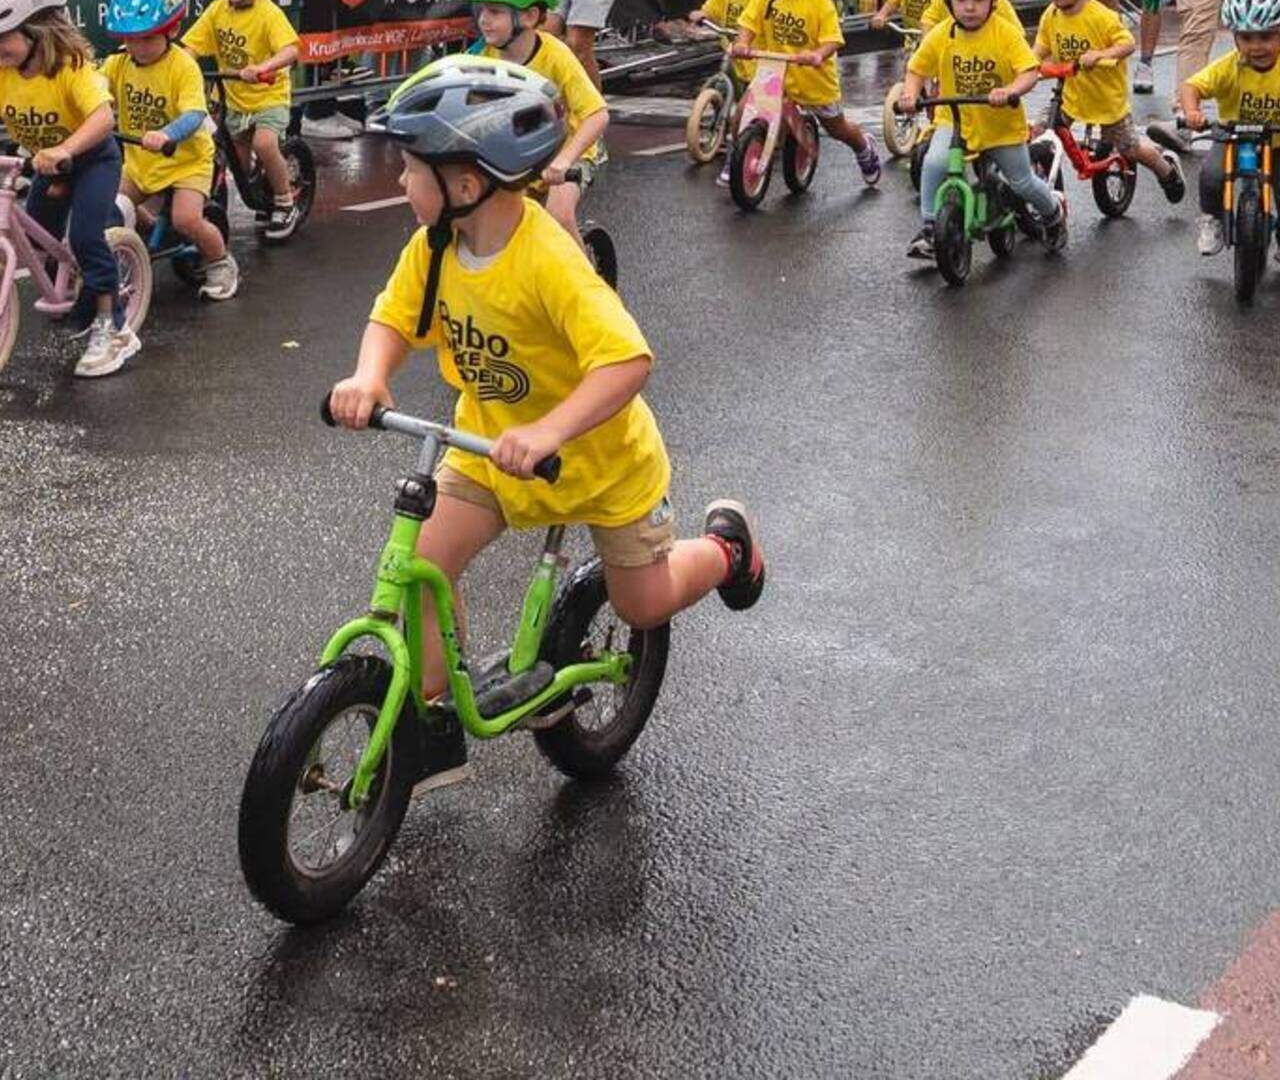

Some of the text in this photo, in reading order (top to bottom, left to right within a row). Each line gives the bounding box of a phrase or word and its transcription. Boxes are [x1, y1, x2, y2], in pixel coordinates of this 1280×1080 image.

[952, 54, 996, 74] Rabo
[124, 82, 167, 110] Rabo
[4, 104, 59, 128] Rabo
